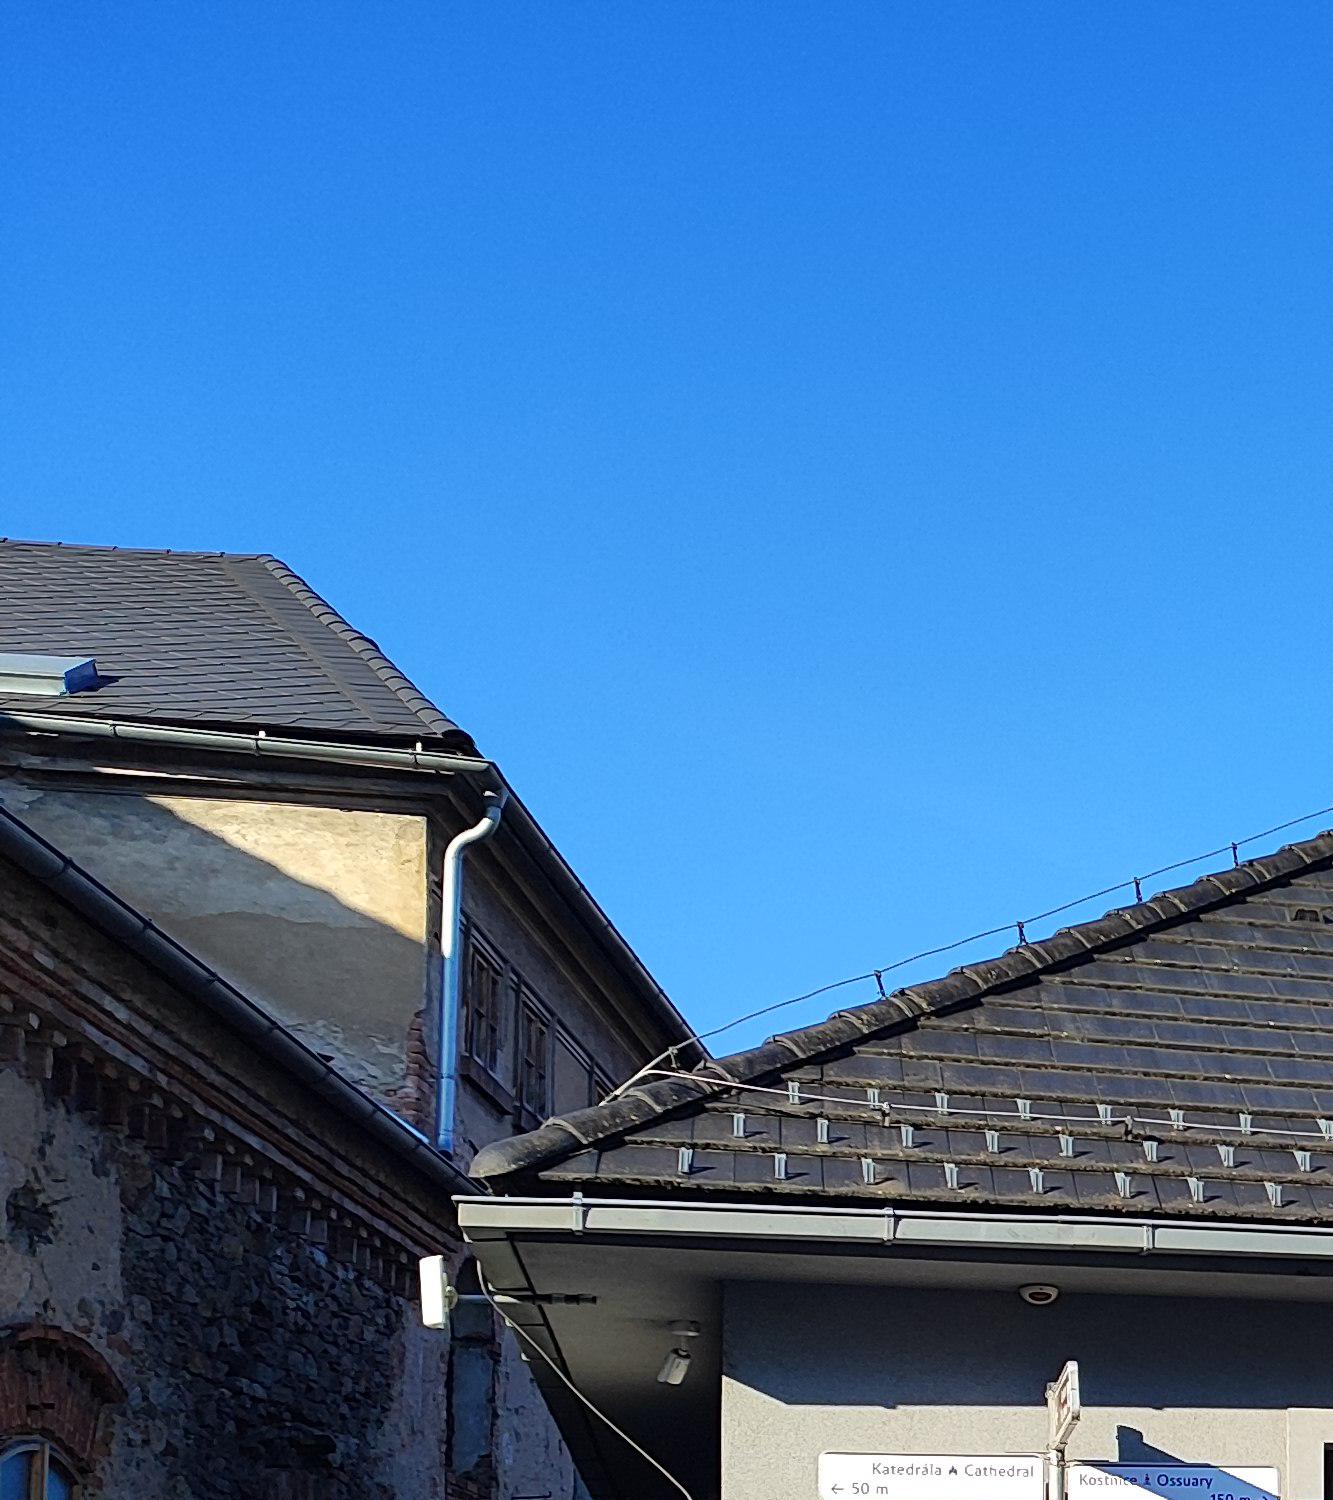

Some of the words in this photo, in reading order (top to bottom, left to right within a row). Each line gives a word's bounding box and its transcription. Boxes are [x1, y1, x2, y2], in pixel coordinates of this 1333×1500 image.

[872, 1462, 942, 1476] Katedrála
[964, 1464, 1034, 1478] Cathedral
[852, 1482, 870, 1495] 50
[876, 1485, 889, 1495] m
[1079, 1474, 1138, 1486] Kostnice
[1156, 1474, 1213, 1489] Ossuary
